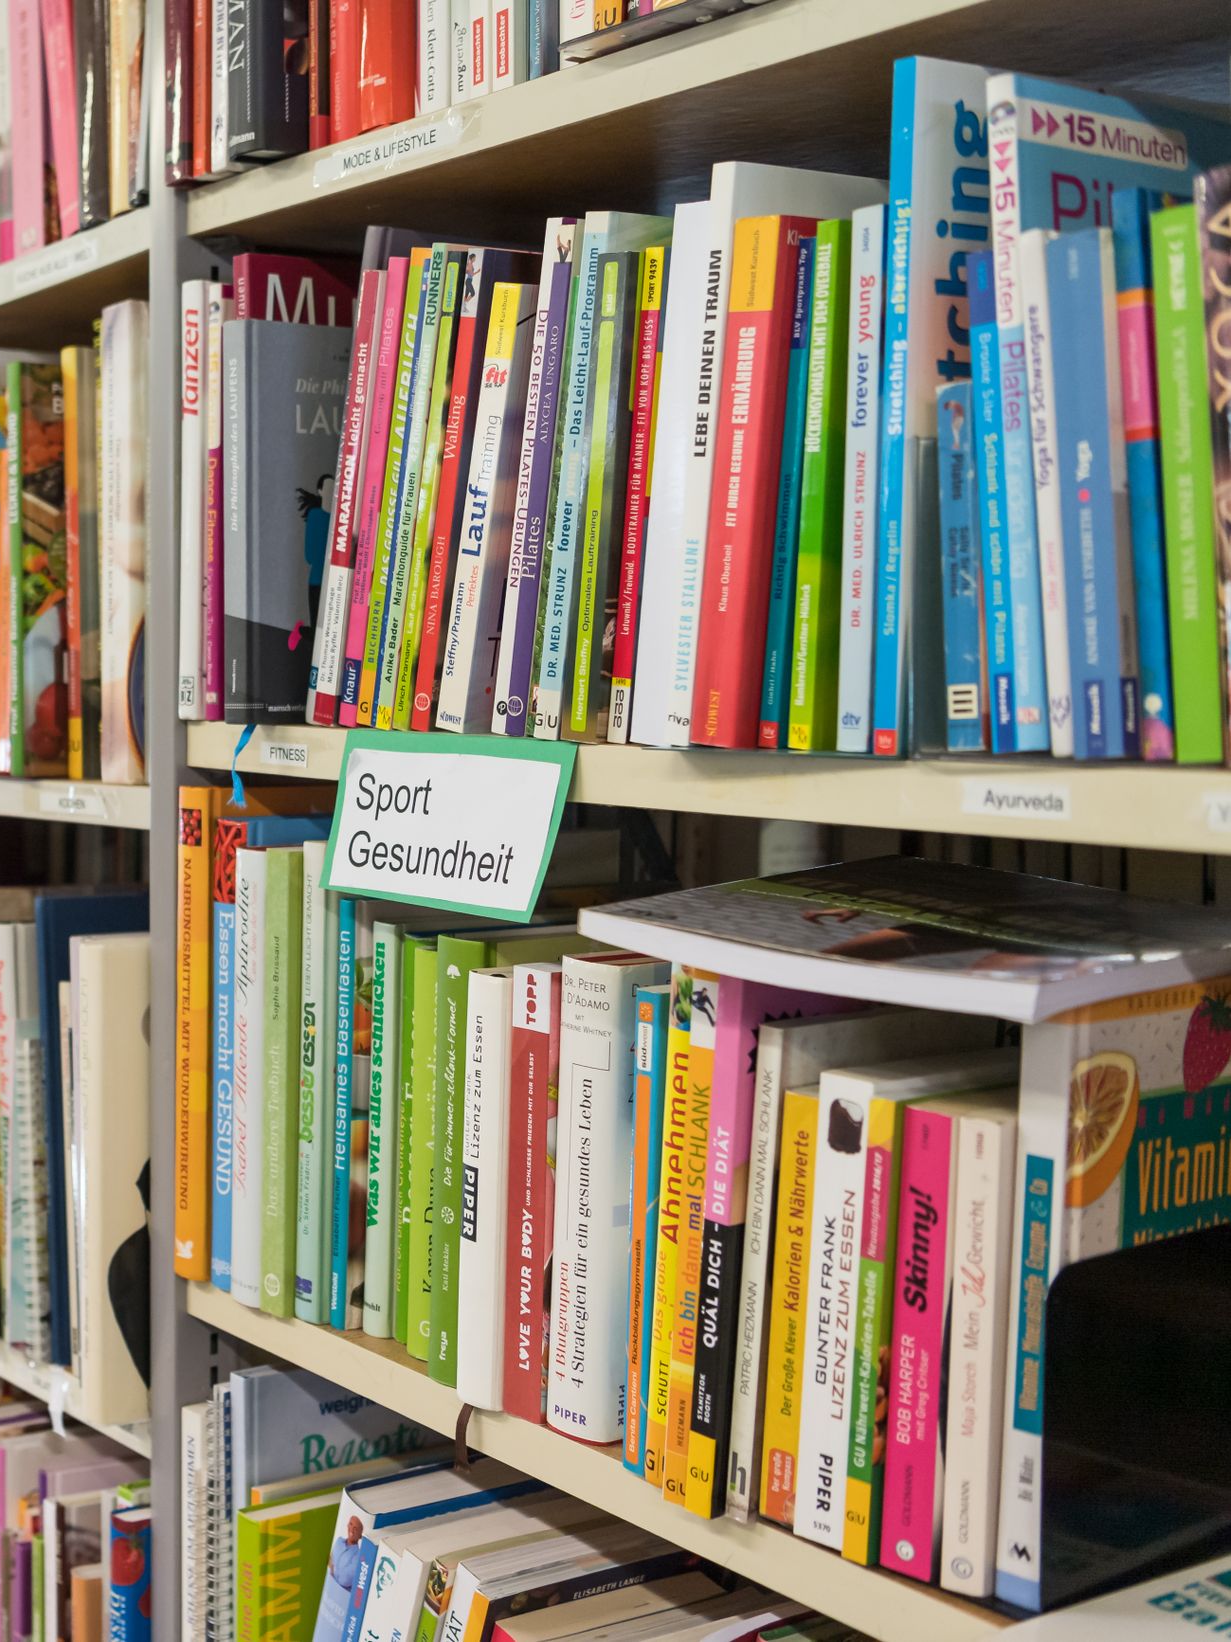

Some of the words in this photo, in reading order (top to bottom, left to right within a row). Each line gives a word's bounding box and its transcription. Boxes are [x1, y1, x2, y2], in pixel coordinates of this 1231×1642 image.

[426, 28, 436, 101] Klett-Cotta
[474, 22, 483, 83] Beobachter
[497, 15, 506, 76] Beobachter
[342, 149, 372, 171] MODE
[373, 146, 381, 162] &
[382, 129, 437, 158] LIFESTYLE
[1064, 113, 1097, 147] 15
[1101, 124, 1186, 165] Minuten
[995, 177, 1016, 211] 15
[425, 250, 443, 326] RUNNERS
[704, 249, 723, 324] TRAUM
[816, 242, 832, 298] OVERBALL
[996, 220, 1016, 323] Minuten
[536, 309, 549, 337] DIE
[573, 247, 599, 405] Leicht-Lauf-Programm
[814, 299, 829, 324] DEM
[856, 274, 876, 344] young
[378, 307, 396, 367] Pilates
[532, 345, 544, 366] 50
[545, 325, 560, 386] UNGARO
[813, 326, 828, 345] MIT
[1027, 304, 1047, 413] Schwangere
[180, 308, 200, 416] Tanzen
[351, 342, 369, 404] gemacht
[697, 329, 716, 405] DEINEN
[731, 326, 757, 425] ERNÄHRUNG
[1003, 341, 1025, 432] Pilates
[526, 373, 540, 431] BESTEN
[805, 347, 827, 453] RÜCKENGYMNASTIK
[851, 352, 870, 428] forever
[887, 340, 908, 436] Stretching
[347, 407, 362, 447] leicht
[442, 394, 465, 460] Walking
[540, 392, 553, 444] ALYCEA
[569, 406, 584, 436] Das
[693, 411, 709, 458] LEBE
[1032, 418, 1048, 443] für
[475, 414, 502, 483] Training
[729, 429, 745, 473] GESUNDE
[1033, 447, 1053, 490] Yoga
[335, 454, 357, 552] MARATHON
[405, 472, 417, 508] Frauen
[727, 475, 741, 509] DURCH
[854, 451, 866, 504] STRUNZ
[401, 511, 412, 526] für
[461, 484, 489, 557] Lauf
[509, 437, 535, 588] PILATES-ÜBUNGEN
[557, 501, 573, 553] forever
[725, 511, 738, 528] FIT
[853, 510, 864, 559] ULRICH
[392, 529, 411, 606] Marathonguide
[430, 535, 446, 599] BAROUGH
[520, 516, 542, 580] Pilates
[585, 510, 598, 575] Lauftraining
[720, 544, 733, 585] Oberbeil
[465, 565, 480, 608] Perfektes
[553, 567, 567, 617] STRUNZ
[680, 538, 700, 608] STALLONE
[852, 565, 863, 599] MED.
[425, 603, 438, 634] NINA
[581, 577, 593, 632] Optimales
[718, 586, 730, 612] Klaus
[850, 605, 862, 628] DR.
[387, 617, 399, 649] Bader
[445, 581, 466, 676] Steffny/Pramann
[550, 622, 563, 652] MED.
[673, 614, 693, 691] SYLVESTER
[384, 652, 396, 683] Anike
[546, 657, 559, 678] DR.
[578, 638, 589, 676] Steffny
[343, 667, 357, 704] Knaur
[574, 678, 586, 721] Herbert
[705, 688, 721, 737] SÜDWEST
[269, 746, 306, 763] FITNESS
[355, 772, 432, 821] Sport
[983, 789, 1065, 813] Ayurveda
[347, 829, 515, 885] Gesundheit
[181, 857, 193, 1015] NAHRUNGSMITTEL
[218, 911, 235, 985] Essen
[235, 876, 255, 1008] Aphrodite
[526, 973, 537, 1026] TOPP
[180, 1020, 191, 1053] MIT
[216, 993, 232, 1072] macht
[473, 1015, 484, 1064] Essen
[639, 1025, 650, 1069] südwest
[233, 1013, 249, 1113] Allende
[267, 1044, 281, 1114] Teebuch
[474, 1069, 482, 1099] zum
[578, 1078, 594, 1133] Leben
[759, 1069, 774, 1133] SCHLANK
[178, 1057, 190, 1210] WUNDERWIRKUNG
[215, 1079, 232, 1197] GESUND
[266, 1121, 279, 1179] andere
[470, 1104, 482, 1160] Lizenz
[687, 1083, 711, 1192] SCHLANK
[714, 1126, 730, 1176] DIÄT
[757, 1137, 768, 1165] MAL
[576, 1137, 594, 1219] gesundes
[711, 1180, 727, 1217] DIE
[753, 1165, 767, 1206] DANN
[789, 1130, 810, 1220] Nährwerte
[266, 1186, 278, 1217] Das
[463, 1167, 476, 1235] PIPER
[685, 1194, 703, 1231] mal
[751, 1206, 764, 1230] BIN
[575, 1222, 589, 1250] ein
[749, 1231, 762, 1256] ICH
[788, 1226, 804, 1238] &
[839, 1189, 857, 1273] ESSEN
[902, 1184, 939, 1314] Skinny!
[573, 1253, 588, 1279] für
[680, 1237, 700, 1286] dann
[706, 1239, 723, 1290] DICH
[784, 1242, 803, 1313] Kalorien
[555, 1261, 571, 1367] Blutgruppen
[571, 1284, 590, 1373] Strategien
[679, 1291, 696, 1322] bin
[701, 1295, 720, 1349] QUÄL
[743, 1280, 759, 1349] HEIZMANN
[835, 1280, 851, 1332] ZUM
[677, 1327, 695, 1357] Ich
[784, 1317, 798, 1355] Klever
[555, 1370, 566, 1383] 4
[571, 1377, 585, 1390] 4
[739, 1352, 754, 1397] PATRIC
[782, 1358, 796, 1394] Große
[830, 1336, 848, 1421] LIZENZ
[898, 1333, 917, 1406] HARPER
[554, 1405, 587, 1426] PIPER
[675, 1398, 687, 1448] HEIZMANN
[780, 1396, 793, 1418] Der
[896, 1407, 913, 1447] BOB
[915, 1420, 926, 1441] mit
[916, 1391, 929, 1420] Greg
[572, 1581, 617, 1601] ELISABETH
[618, 1574, 646, 1590] LANGE
